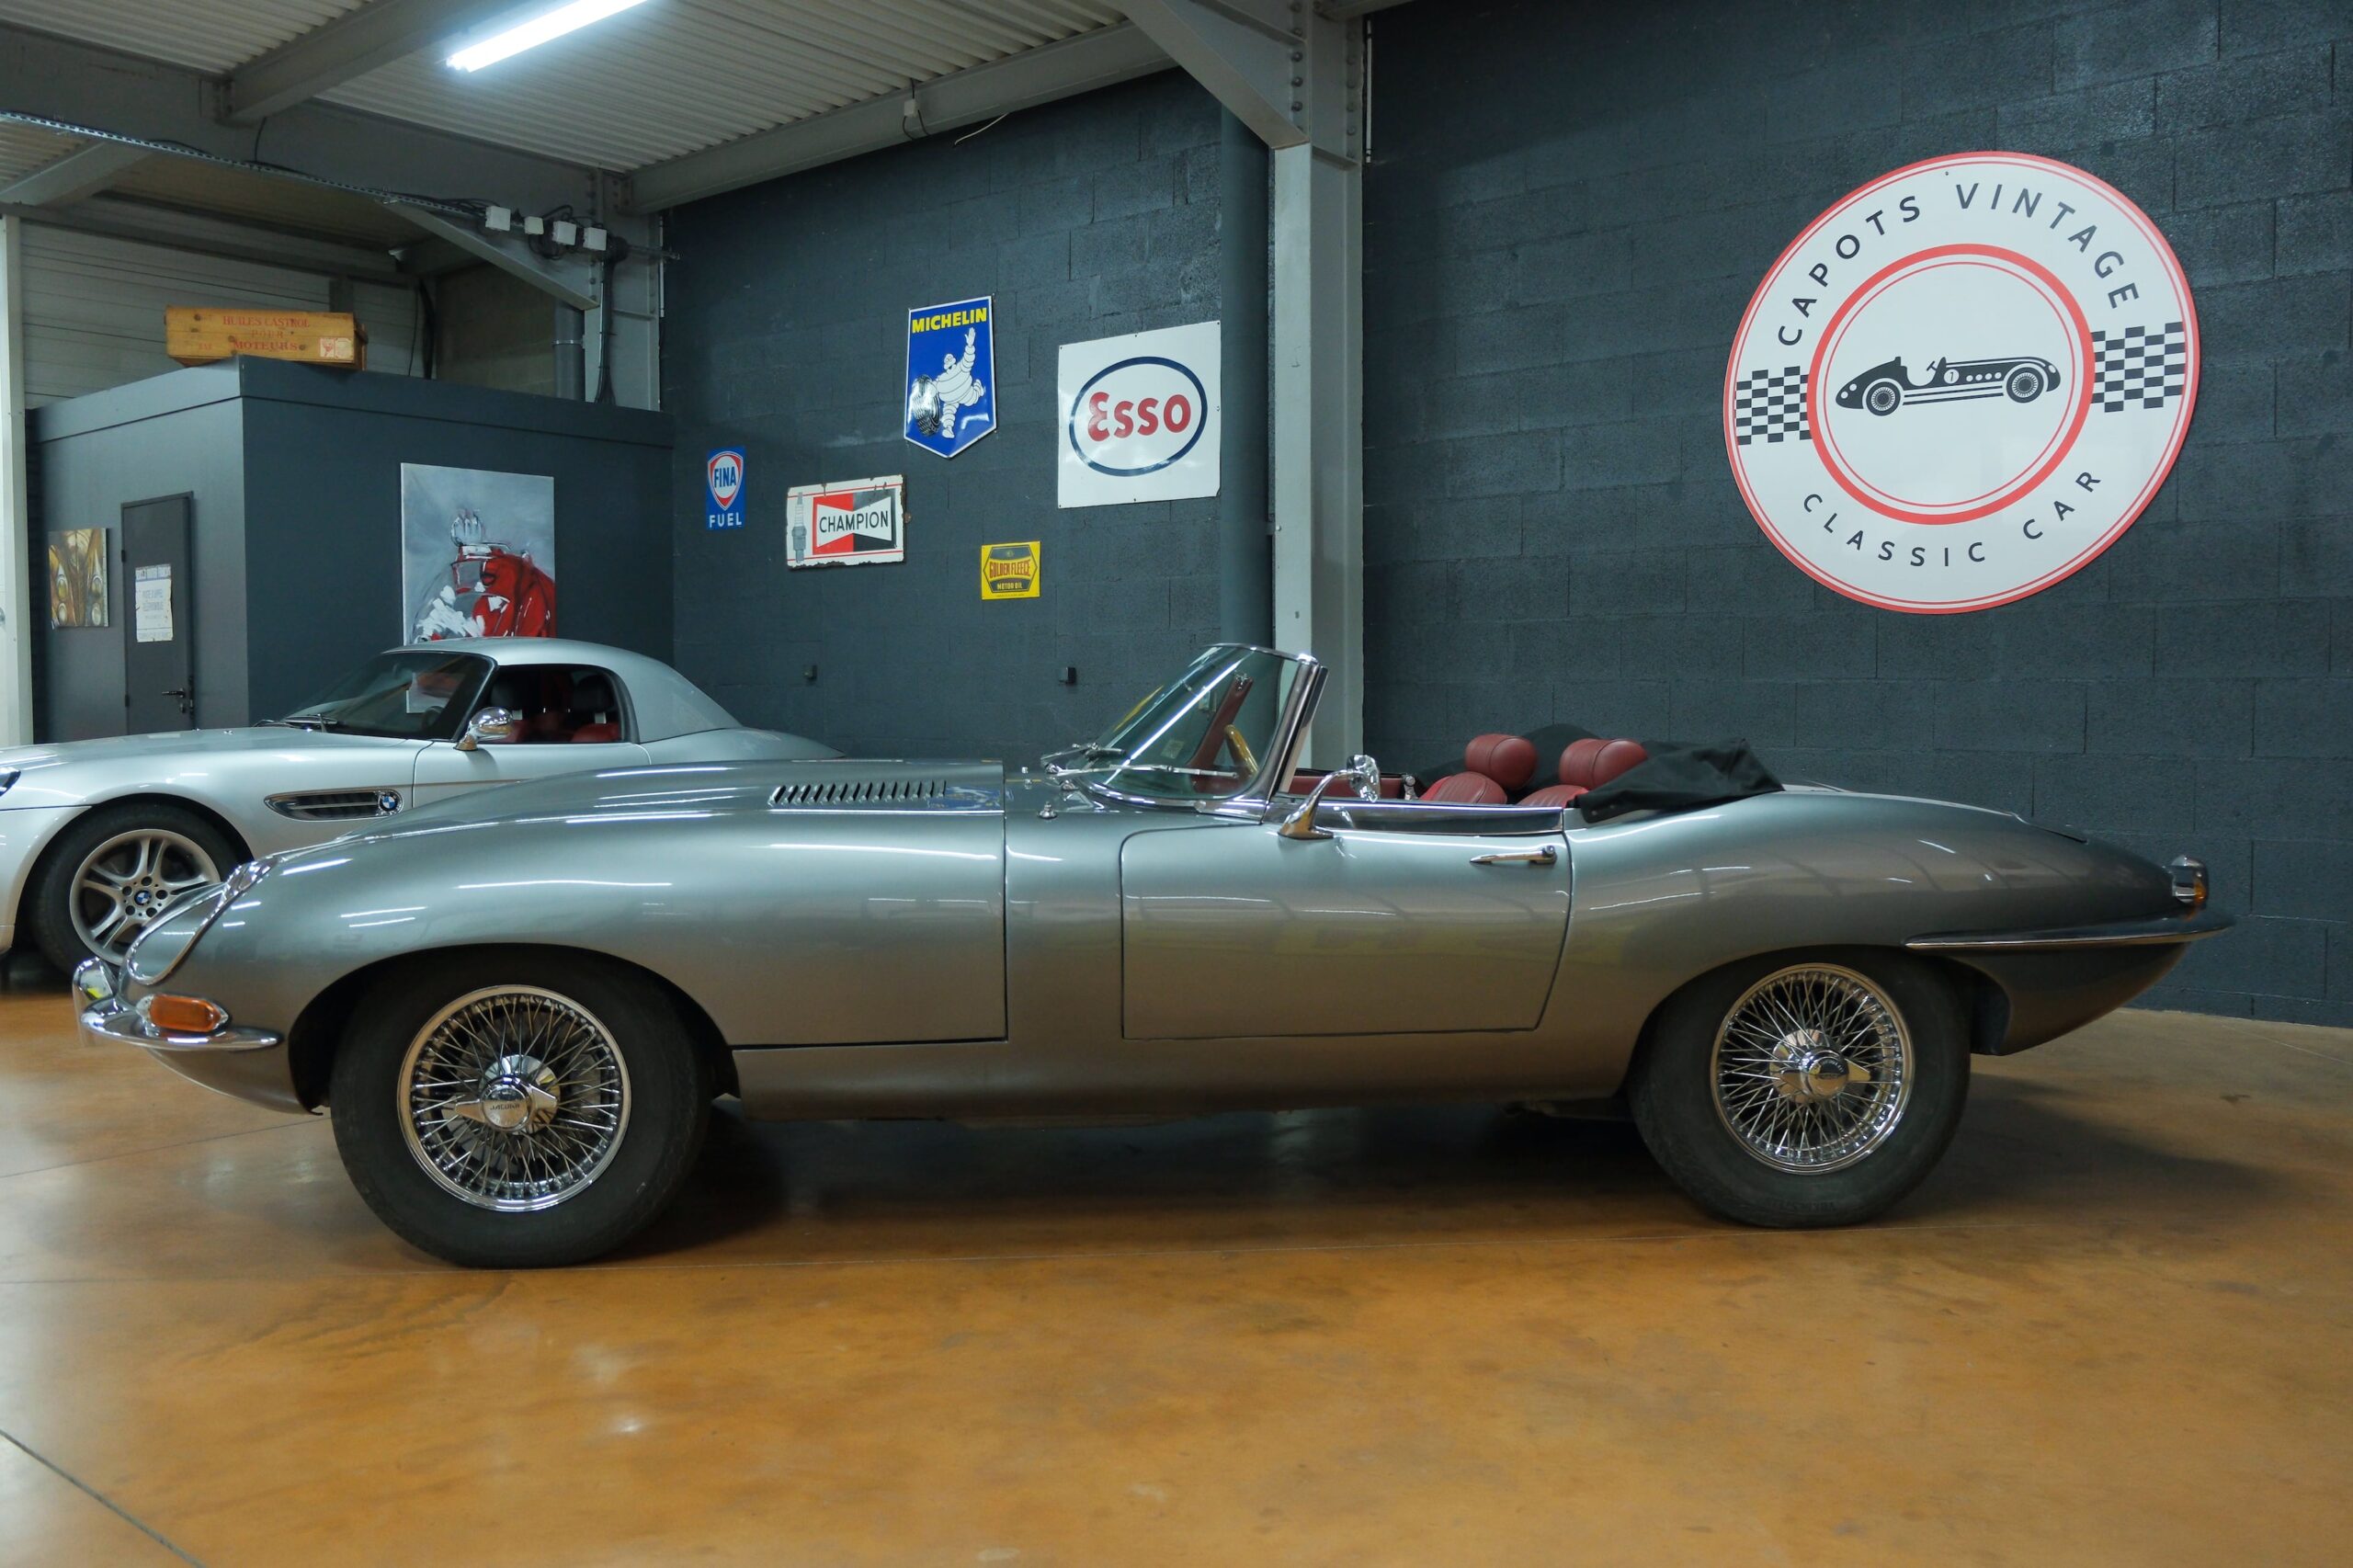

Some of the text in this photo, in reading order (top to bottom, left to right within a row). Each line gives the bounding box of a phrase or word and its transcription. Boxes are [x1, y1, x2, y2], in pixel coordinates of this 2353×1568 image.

[1778, 183, 2140, 346] CAPOTS VINTAGE
[264, 317, 310, 327] CASTROL
[912, 308, 987, 334] MICHELIN
[233, 341, 298, 350] MOTEURS
[714, 466, 736, 487] FINA
[709, 512, 742, 528] FUEL
[819, 510, 888, 532] CHAMPION
[1803, 472, 2101, 567] CLASSIC CAR
[989, 559, 1030, 578] GOLDEN FLEECE
